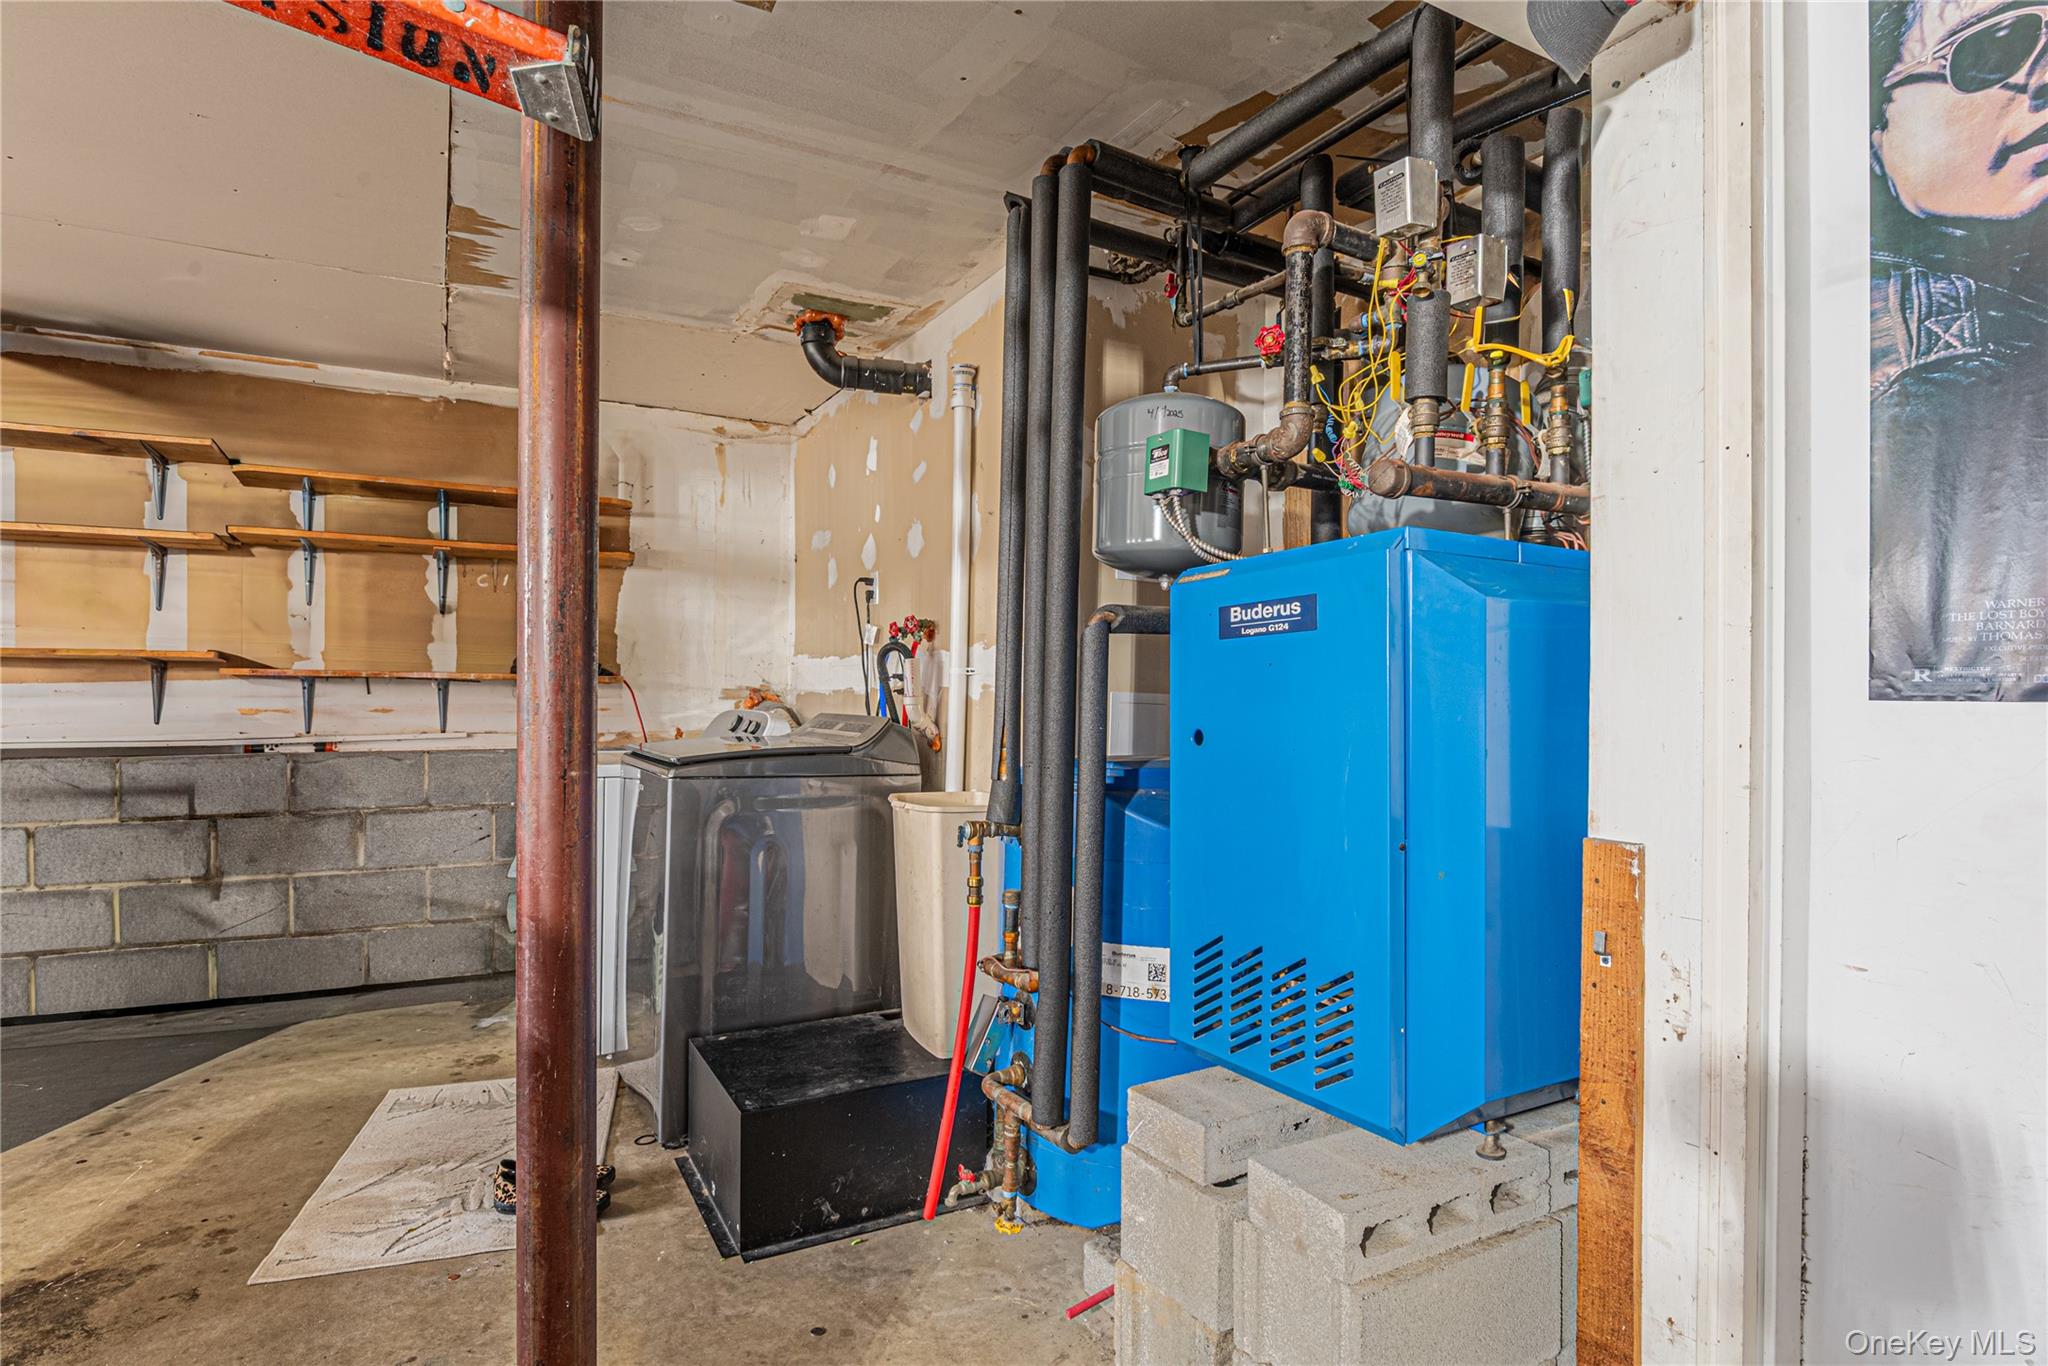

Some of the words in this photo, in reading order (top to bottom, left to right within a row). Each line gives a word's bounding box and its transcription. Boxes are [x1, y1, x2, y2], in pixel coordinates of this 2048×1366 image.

[1984, 597, 2047, 609] WARNER
[1230, 601, 1301, 623] Buderus
[1979, 609, 2016, 620] LOST
[1241, 626, 1267, 635] Logano
[1268, 623, 1289, 632] G124
[1976, 620, 2046, 631] BARNARD
[1980, 631, 2043, 641] THOMAS
[1912, 668, 1932, 682] R
[1106, 983, 1167, 1000] 8-718-573
